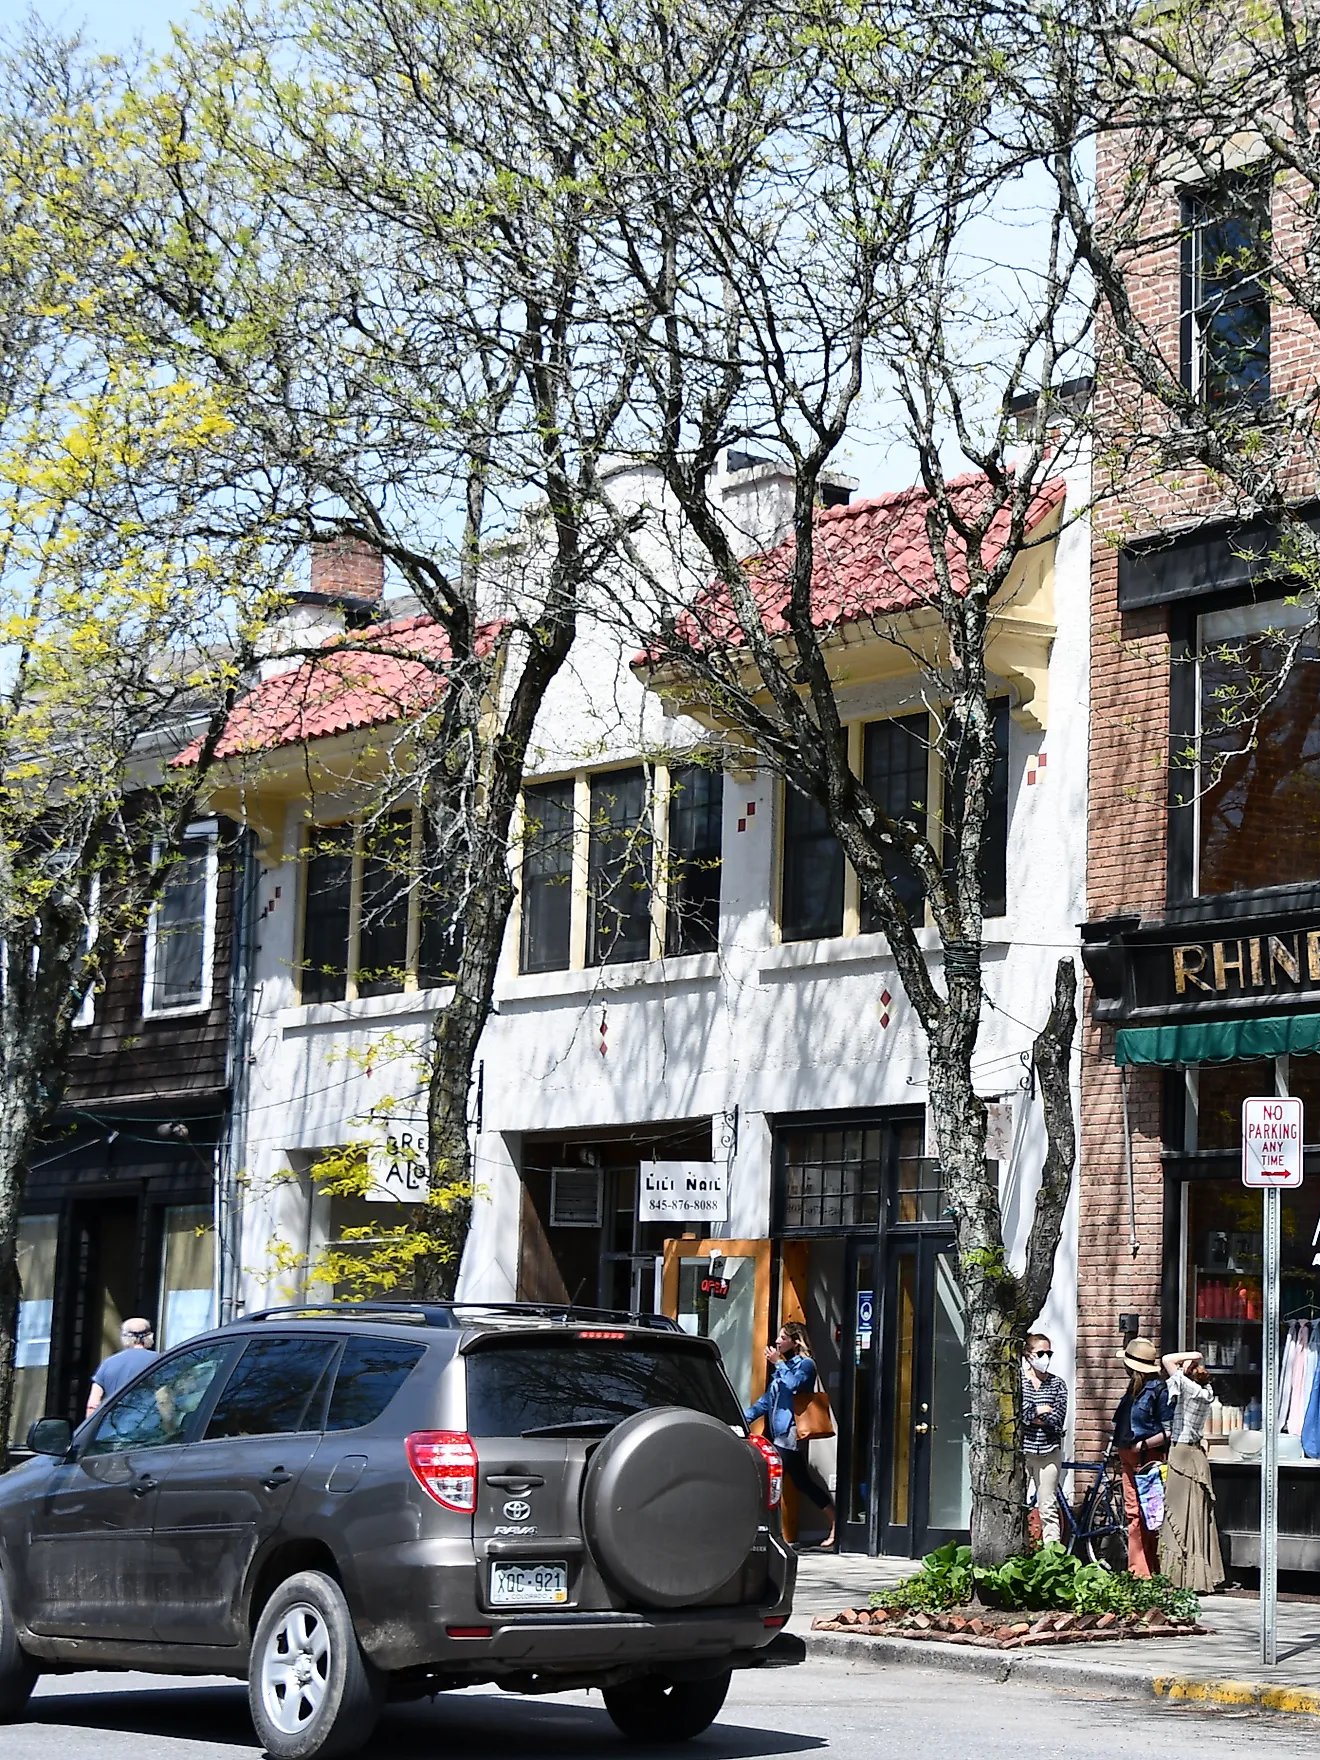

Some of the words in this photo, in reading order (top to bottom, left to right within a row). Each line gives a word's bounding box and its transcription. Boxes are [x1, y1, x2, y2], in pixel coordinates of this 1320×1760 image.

[1263, 1105, 1283, 1121] NO
[1248, 1123, 1297, 1139] PARKING
[1262, 1142, 1283, 1153] ANY
[1261, 1155, 1285, 1166] TIME
[649, 1199, 718, 1211] 845-876-8088
[493, 1525, 539, 1536] RAV4
